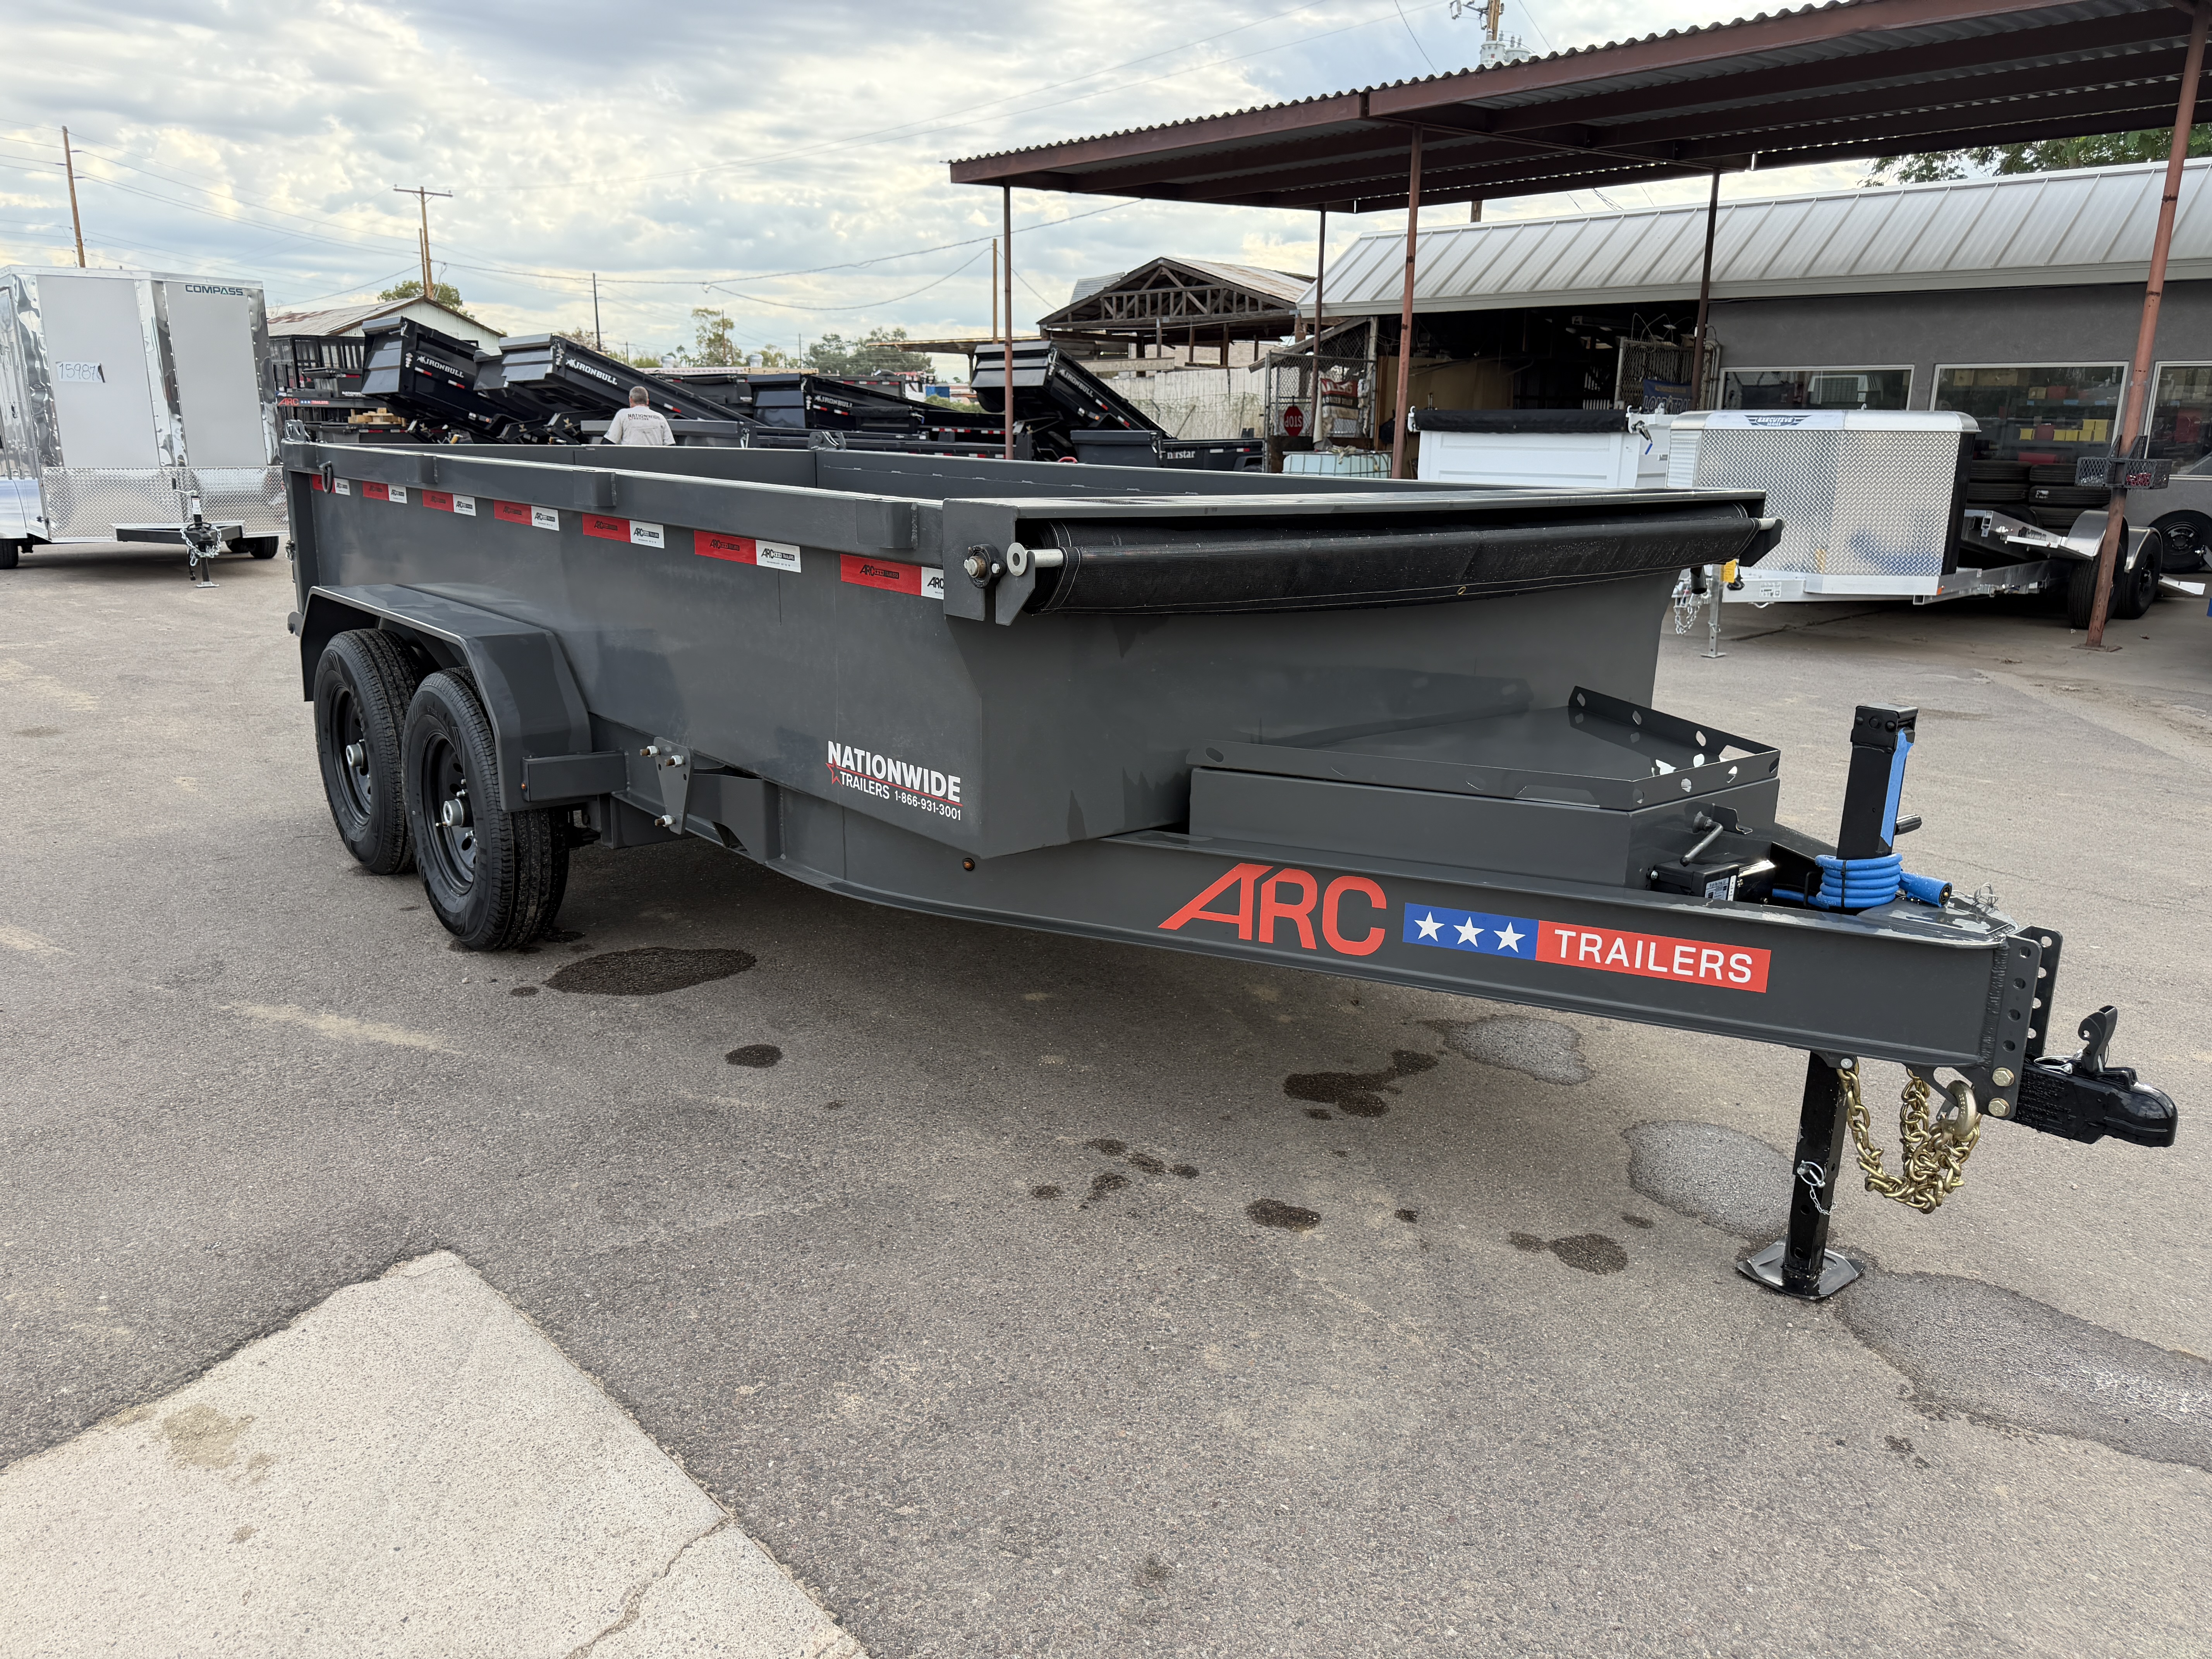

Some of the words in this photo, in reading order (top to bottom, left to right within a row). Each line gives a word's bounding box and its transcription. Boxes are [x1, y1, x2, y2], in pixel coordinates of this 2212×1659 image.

[185, 285, 243, 296] COMPASS
[426, 358, 464, 378] IRONBULL
[574, 361, 618, 385] IRONBULL
[1066, 372, 1094, 397] IRONBULL
[278, 398, 299, 406] ARC
[1285, 416, 1302, 428] STOP
[633, 527, 644, 537] ARC
[761, 548, 775, 559] ARC
[860, 564, 876, 577] ARC
[828, 740, 961, 803] NATIONWIDE
[840, 771, 890, 800] TRAILERS
[895, 790, 961, 821] 1-866-931-3001
[1158, 862, 1387, 956] ARC
[1554, 929, 1752, 983] TRAILERS
